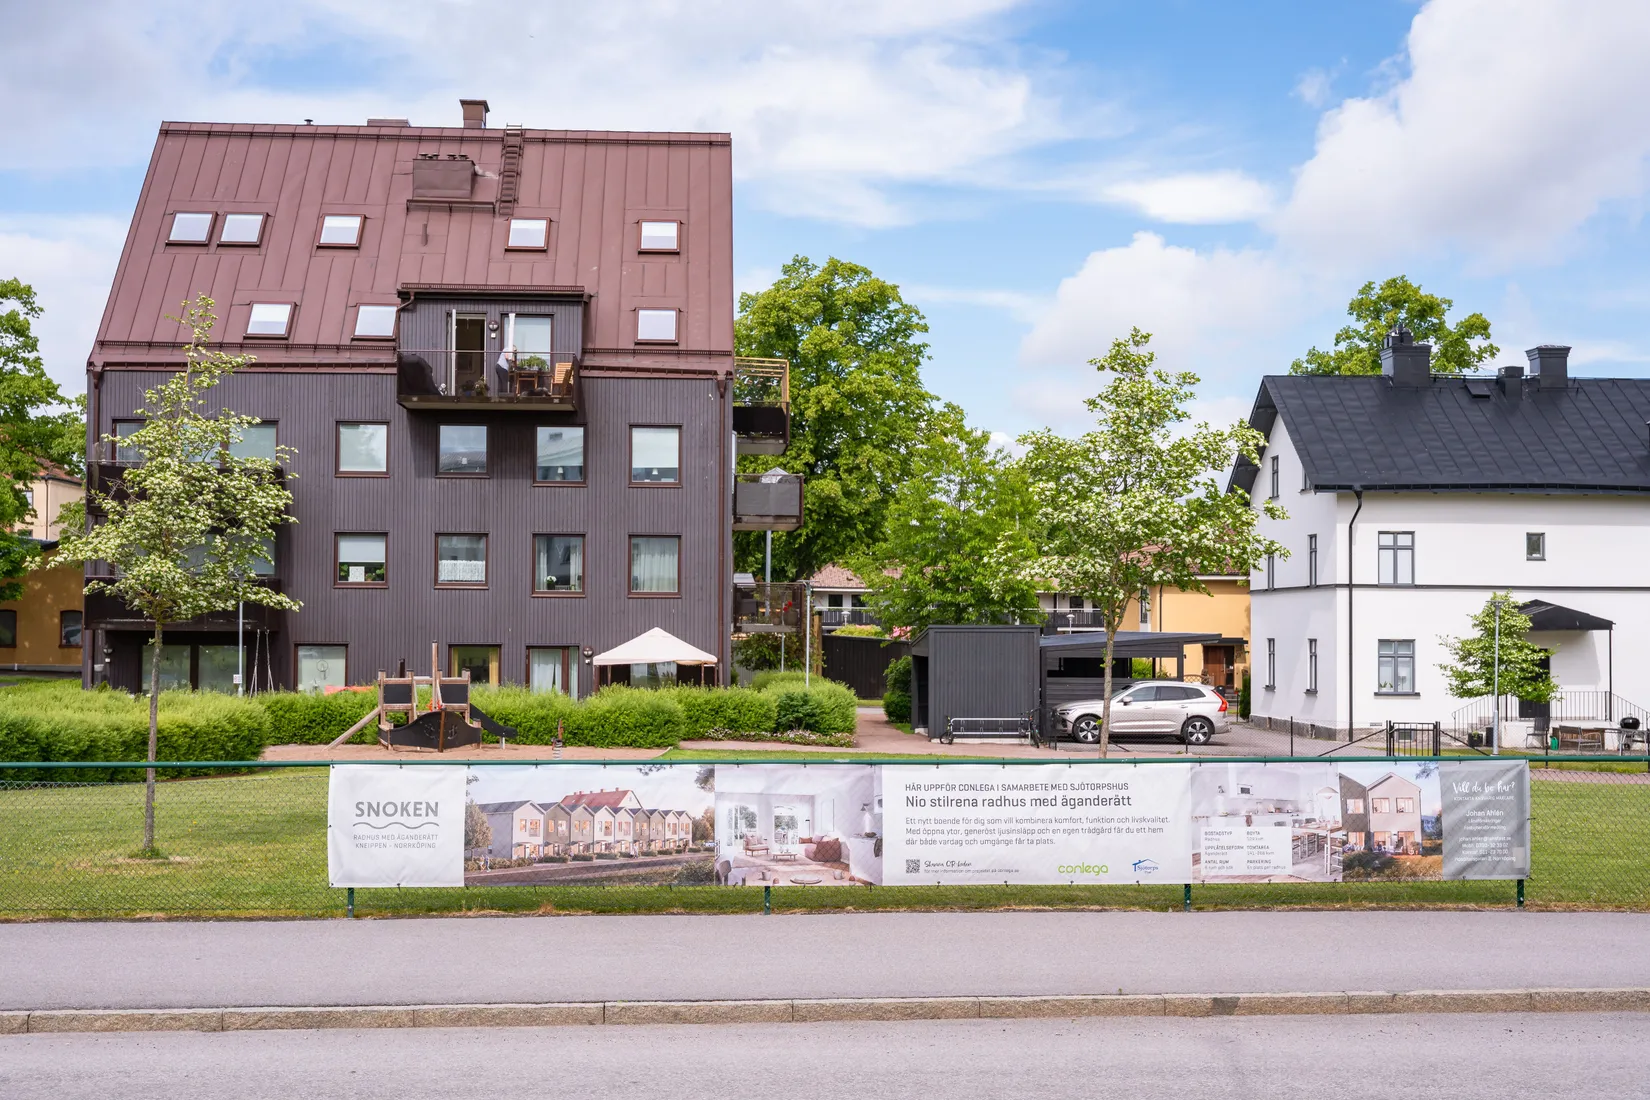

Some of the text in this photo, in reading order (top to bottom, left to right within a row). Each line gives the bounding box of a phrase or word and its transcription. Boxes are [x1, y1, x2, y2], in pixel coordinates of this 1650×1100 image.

[924, 782, 956, 791] UPPFÖR
[1070, 782, 1128, 790] SJÖTORPSHUS
[1453, 781, 1470, 793] Vill
[1472, 782, 1482, 792] du
[1484, 782, 1494, 792] bo
[906, 795, 1131, 809] Nio stilrena radhus med äganderätt
[356, 802, 438, 817] SNOKEN
[918, 818, 932, 826] nytt
[974, 817, 985, 826] dig
[923, 828, 944, 836] öppna
[965, 828, 996, 836] generöst
[998, 827, 1036, 836] ljusinsläpp
[1082, 827, 1112, 835] trädgård
[939, 838, 963, 846] vardag
[980, 838, 1013, 846] umgänge
[1058, 862, 1108, 876] conlega
